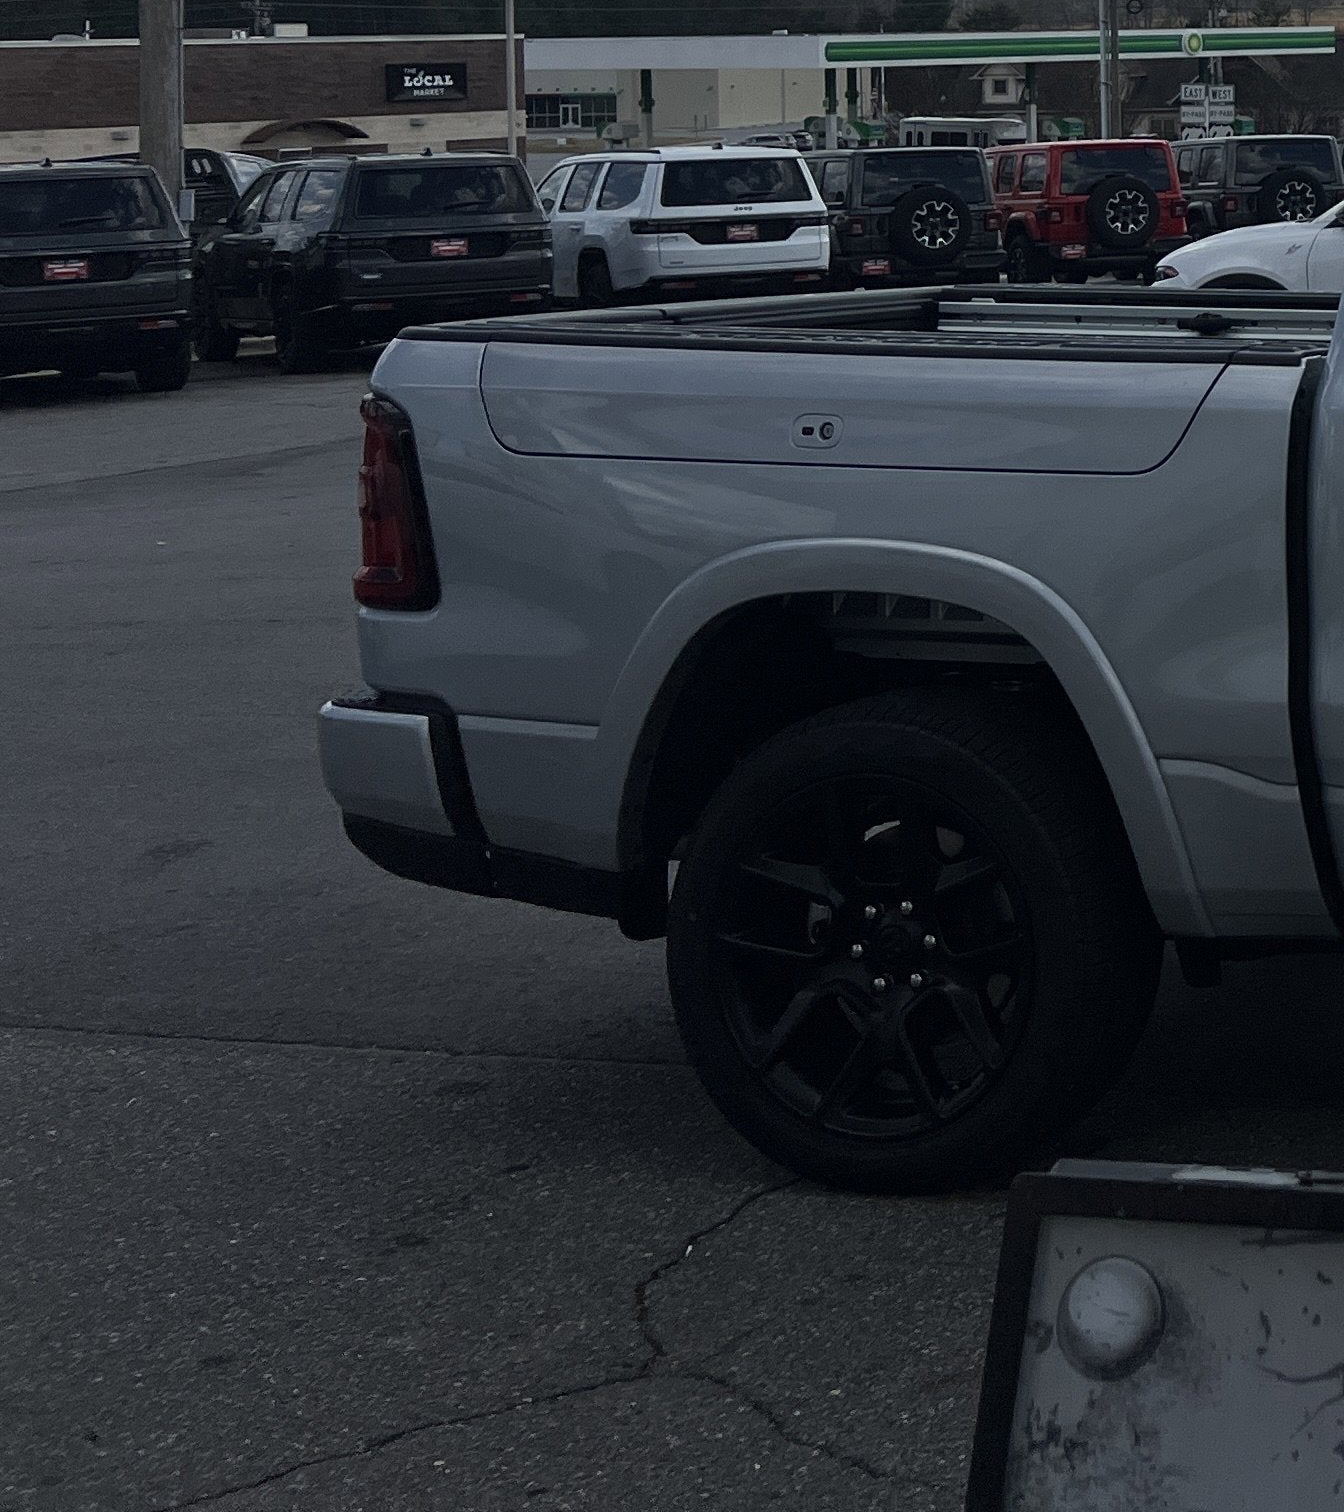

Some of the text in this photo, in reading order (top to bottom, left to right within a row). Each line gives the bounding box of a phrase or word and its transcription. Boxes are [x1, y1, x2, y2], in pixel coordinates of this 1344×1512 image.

[404, 71, 453, 86] LOCAL
[1184, 87, 1202, 98] EAST
[1211, 89, 1231, 99] WEST
